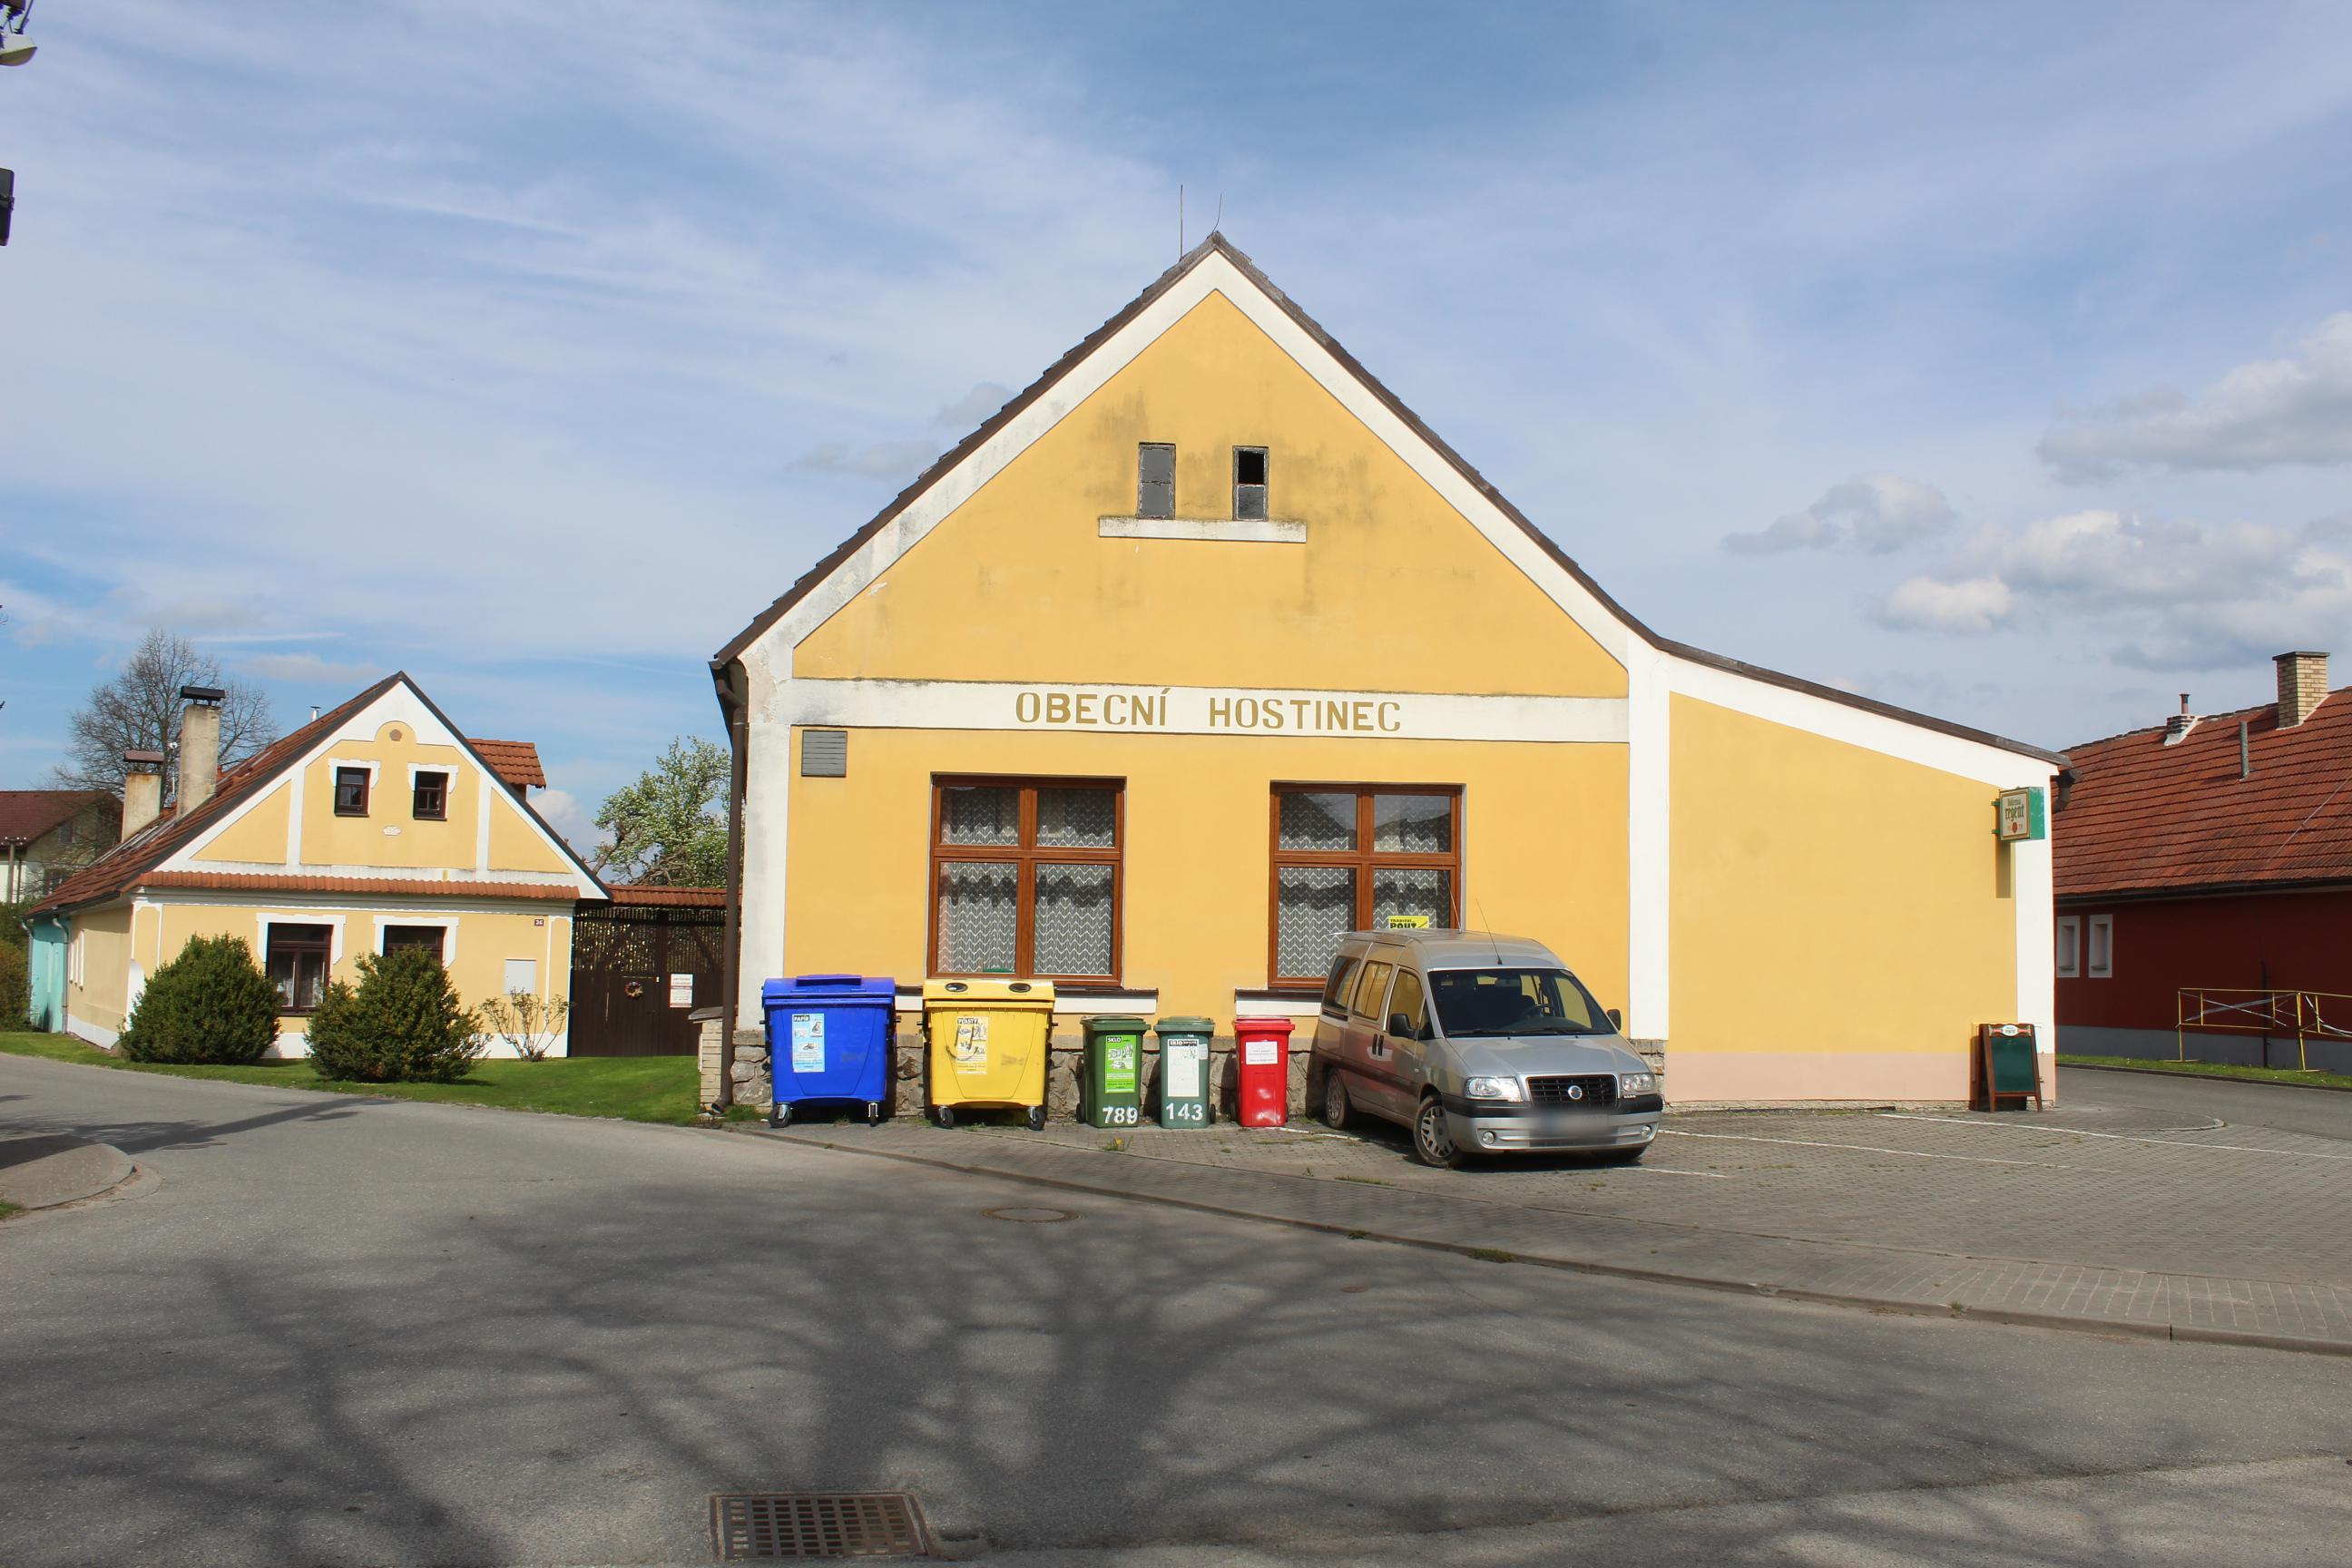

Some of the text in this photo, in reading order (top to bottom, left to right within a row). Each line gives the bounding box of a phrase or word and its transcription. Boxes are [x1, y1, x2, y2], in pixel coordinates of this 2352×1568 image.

[1015, 688, 1401, 732] OBECNÍ HOSTINEC
[1102, 1106, 1139, 1124] 789
[1166, 1102, 1203, 1121] 143
